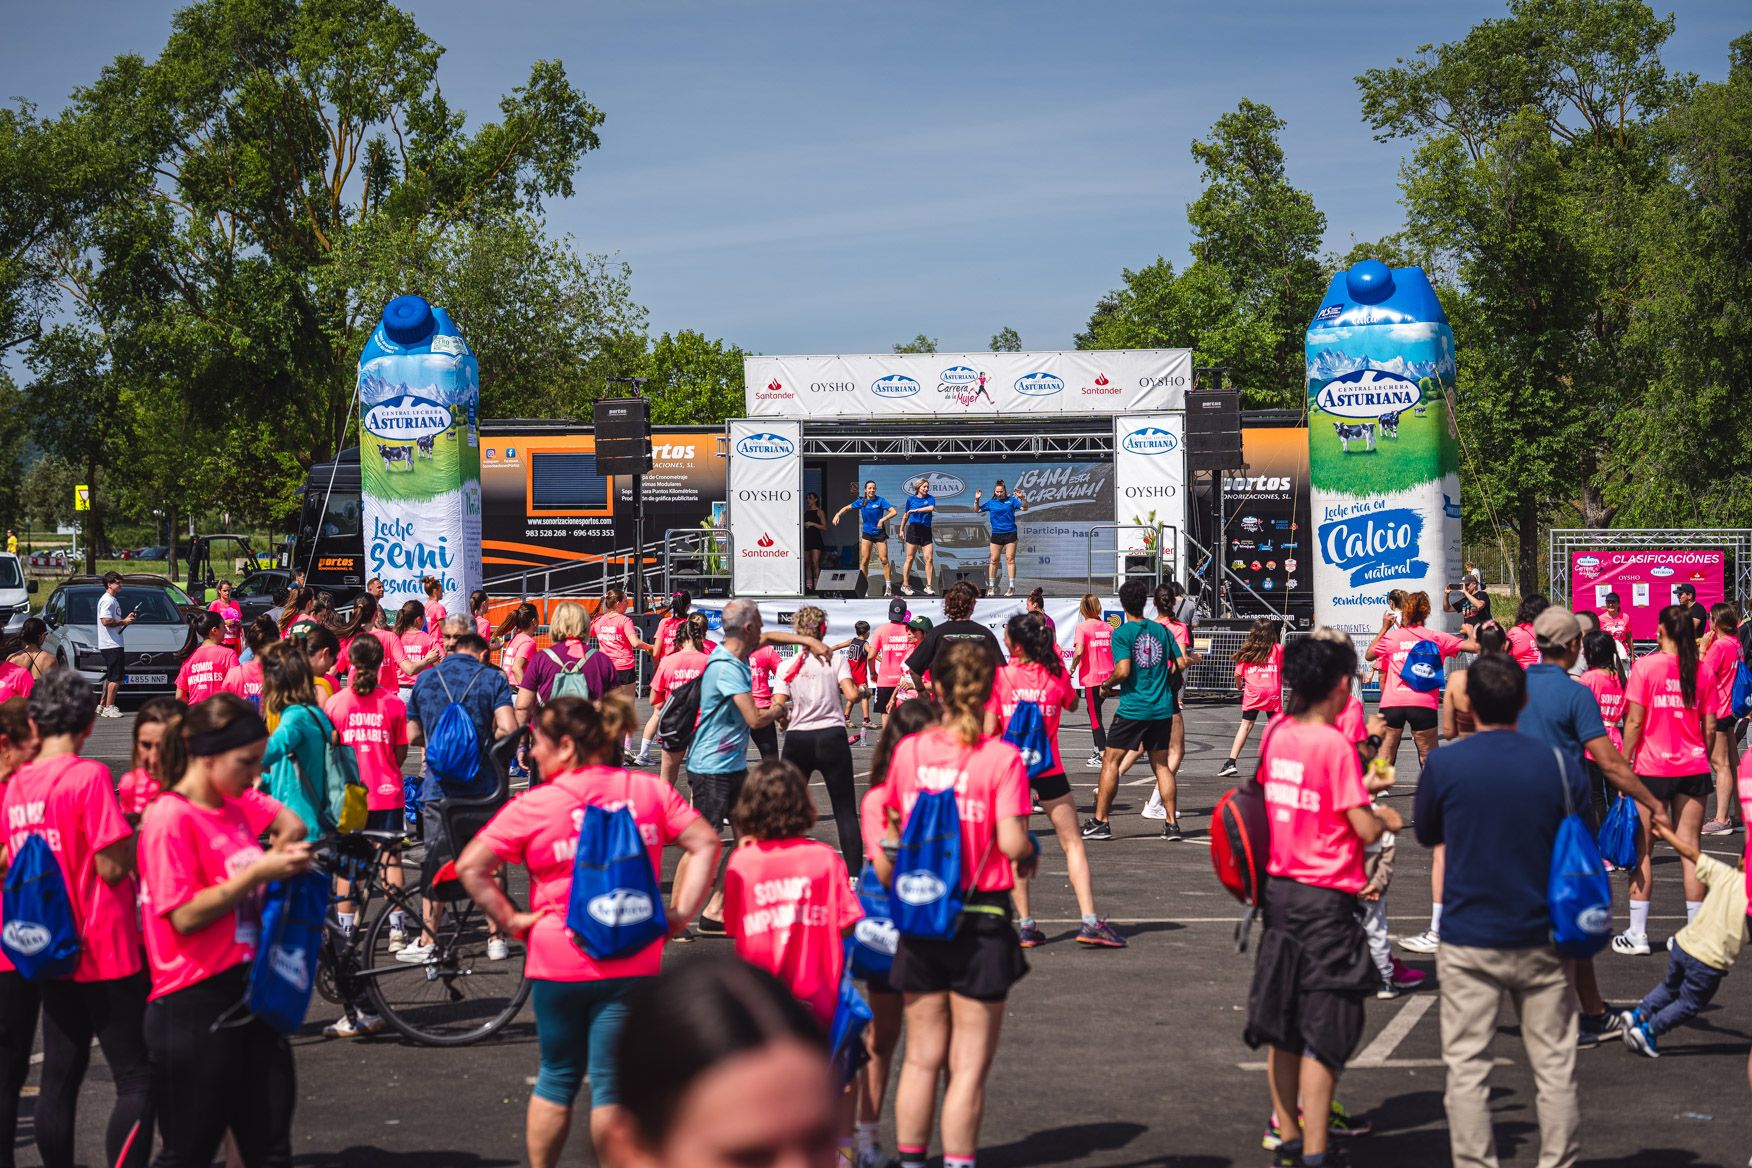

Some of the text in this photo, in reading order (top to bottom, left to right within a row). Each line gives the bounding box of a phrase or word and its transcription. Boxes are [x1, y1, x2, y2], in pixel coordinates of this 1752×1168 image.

[810, 382, 855, 392] OYSHO
[875, 382, 917, 392] ASTURIANA
[1018, 381, 1062, 391] ASTURIANA
[1139, 376, 1185, 387] OYSHO
[937, 383, 969, 393] Carrera
[1081, 387, 1122, 395] Santander
[1338, 385, 1371, 393] CENTRAL
[755, 391, 795, 400] Santander
[956, 392, 980, 406] Mujer
[1323, 389, 1413, 408] ASTURIANA
[369, 412, 446, 430] ASTURIANA
[741, 443, 790, 453] ASTURIANA
[1127, 438, 1174, 448] ASTURIANA
[652, 444, 695, 459] rtos
[739, 489, 792, 502] OYSHO
[1026, 478, 1105, 503] CARAVANA!
[1125, 485, 1176, 498] OYSHO
[1324, 500, 1385, 522] Leche rica en
[527, 517, 612, 526] www.sonorizacionesportos.com
[372, 516, 416, 543] Leche
[1327, 520, 1411, 564] Calcio
[370, 536, 455, 573] semi
[742, 548, 789, 558] Santander
[1612, 553, 1720, 564] CLASIFICACIÓNES
[318, 557, 354, 567] portos
[1364, 559, 1411, 580] natural
[1332, 591, 1391, 606] semidesnat
[404, 645, 422, 654] OMOS
[191, 661, 213, 674] SOMOS
[244, 683, 262, 694] SOM
[349, 712, 384, 727] SOMOS
